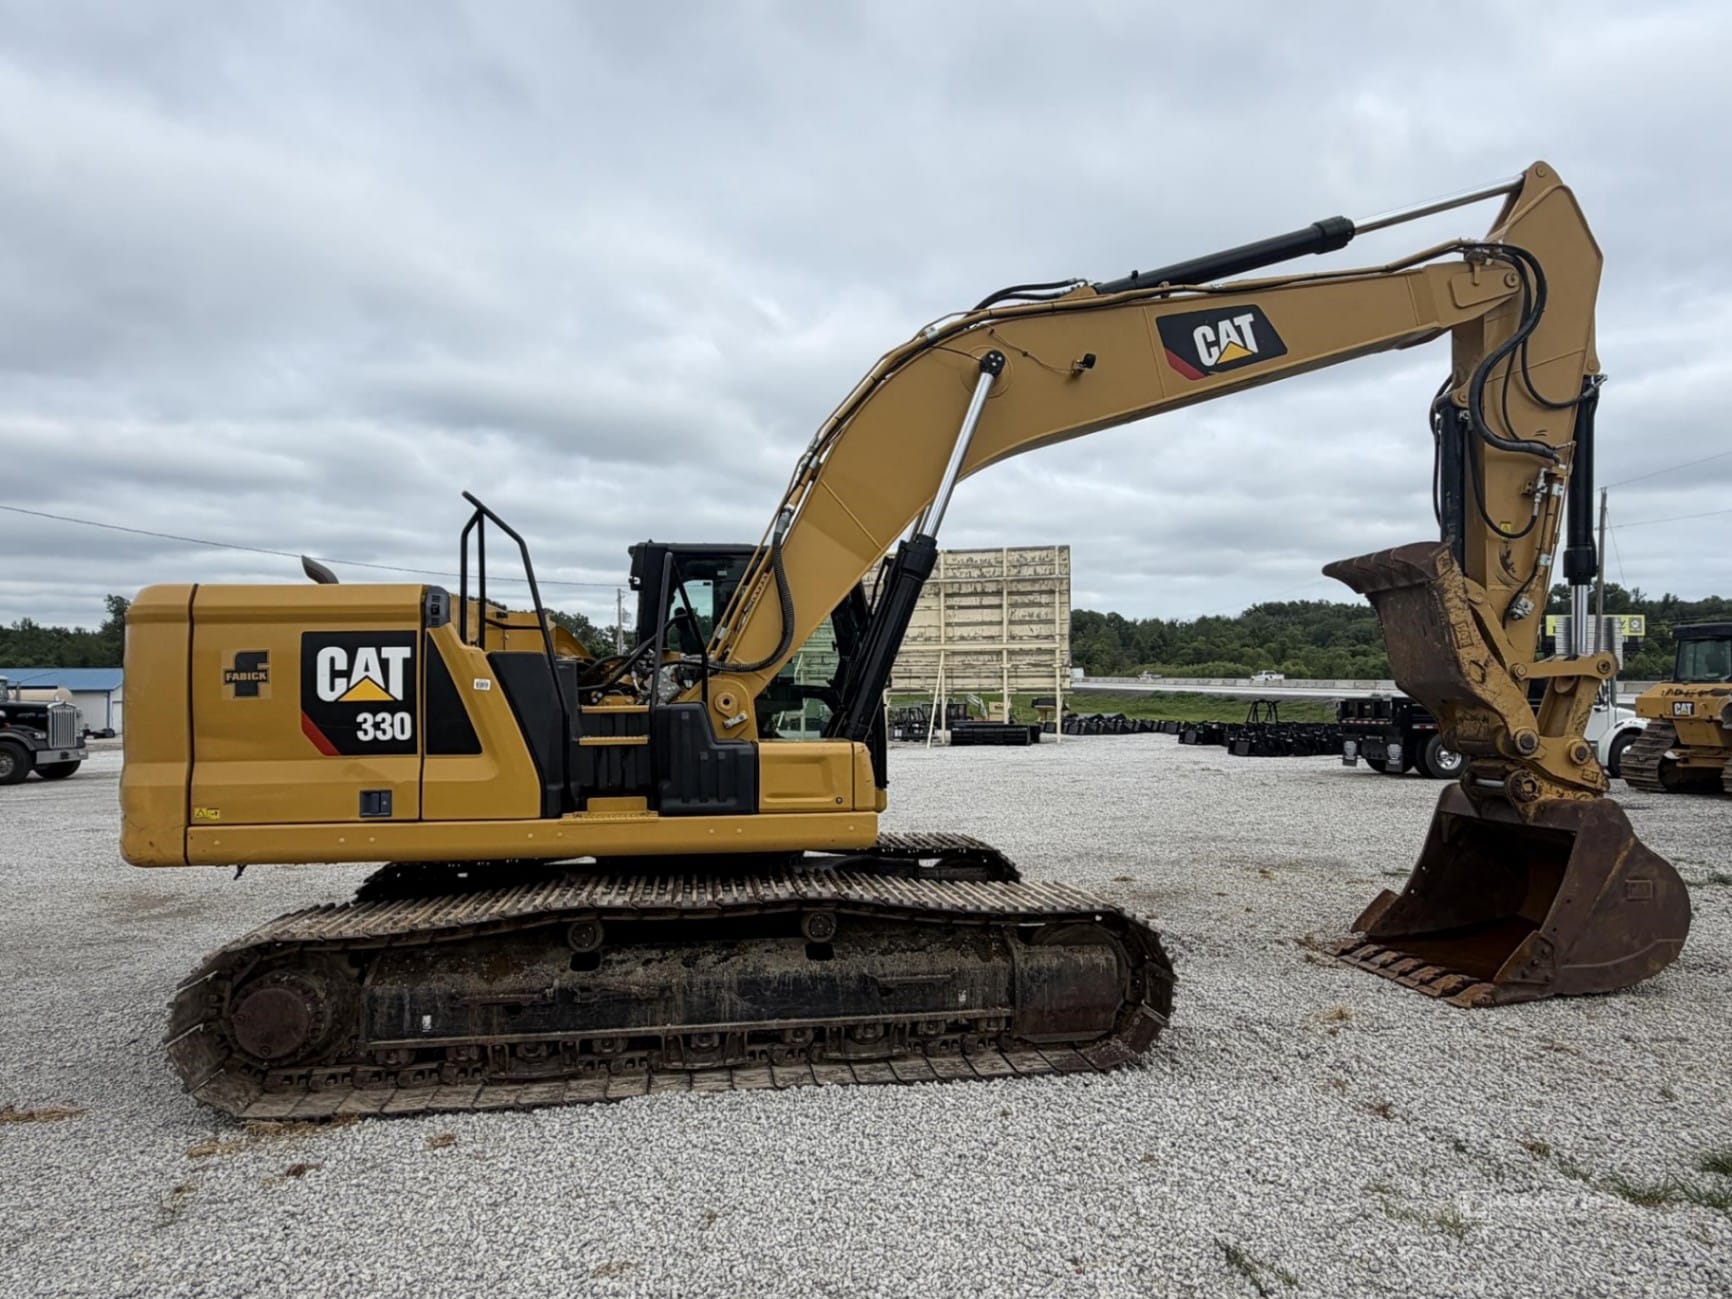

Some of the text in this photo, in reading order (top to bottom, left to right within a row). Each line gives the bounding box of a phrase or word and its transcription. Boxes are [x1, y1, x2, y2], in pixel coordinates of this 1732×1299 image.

[1193, 313, 1259, 367] CAT
[225, 672, 267, 681] FABICK
[316, 646, 412, 702] CAT
[1674, 702, 1692, 716] CAT
[356, 711, 412, 742] 330
